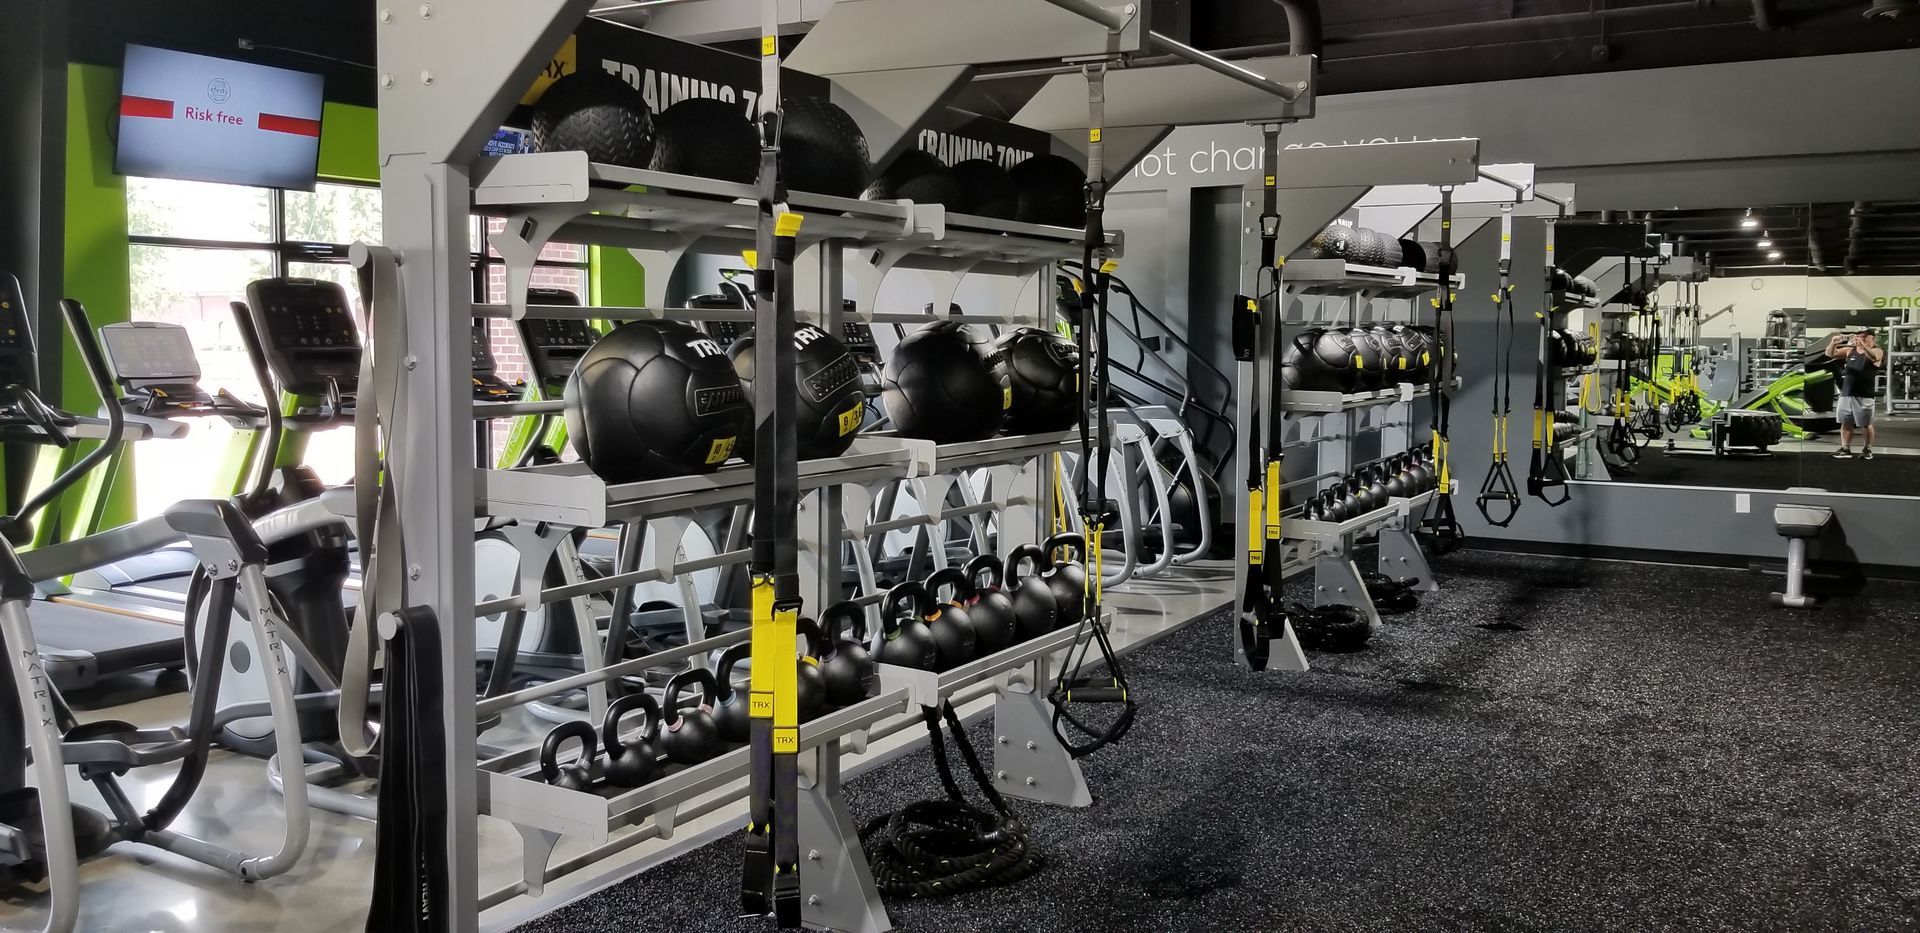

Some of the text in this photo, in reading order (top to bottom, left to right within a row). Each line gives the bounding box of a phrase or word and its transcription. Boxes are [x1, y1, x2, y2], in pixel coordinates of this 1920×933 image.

[185, 106, 243, 125] Risk free
[686, 338, 727, 359] TRX
[571, 555, 593, 610] MATIX
[259, 606, 286, 676] MATRIX
[22, 649, 54, 727] MATRIX
[752, 701, 771, 709] TRX
[775, 736, 795, 744] TRX
